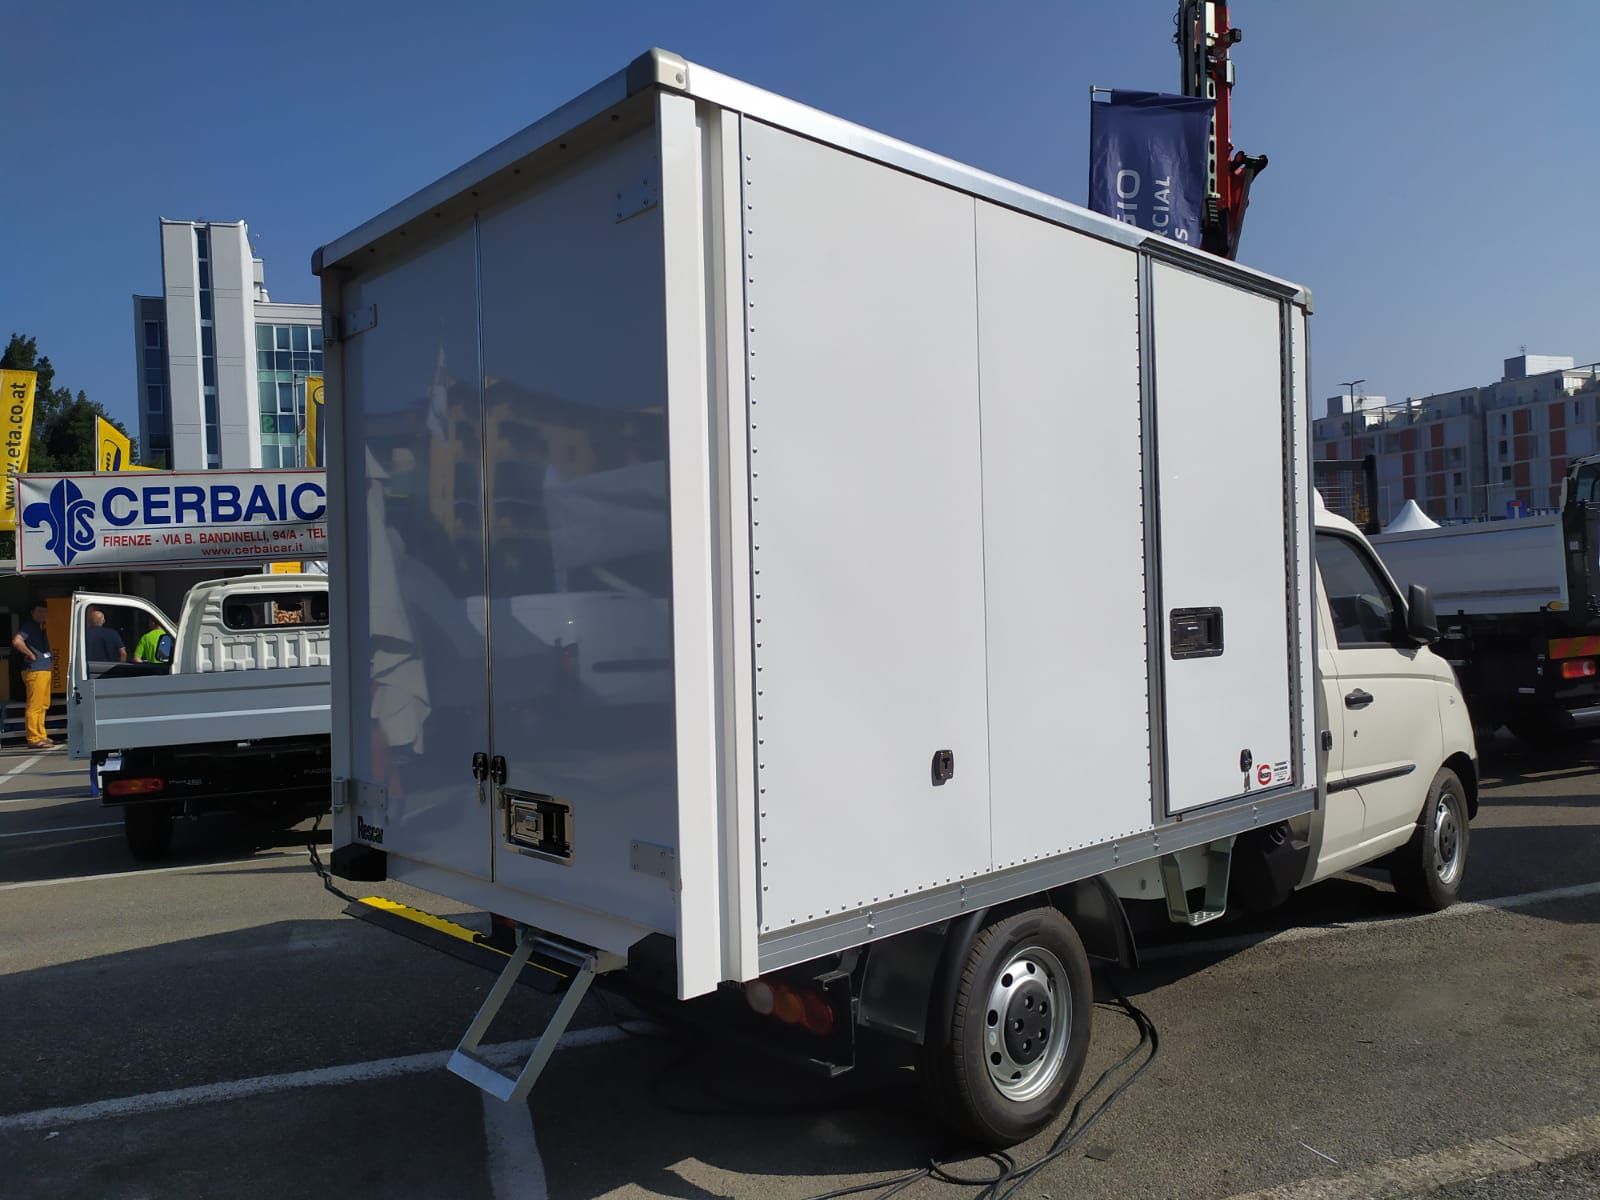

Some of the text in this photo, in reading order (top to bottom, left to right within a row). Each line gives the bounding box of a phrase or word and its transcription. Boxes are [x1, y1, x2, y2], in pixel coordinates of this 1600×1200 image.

[5, 382, 26, 511] www.eta.co.at
[102, 482, 326, 527] CERBAIC
[103, 534, 152, 547] FIRENZE
[162, 534, 182, 545] VIA
[184, 532, 196, 545] B.
[199, 530, 270, 544] BANDINELLI,
[272, 529, 297, 541] 94/A
[201, 542, 304, 556] www.cerbaicar.it
[357, 815, 384, 844] Rescar
